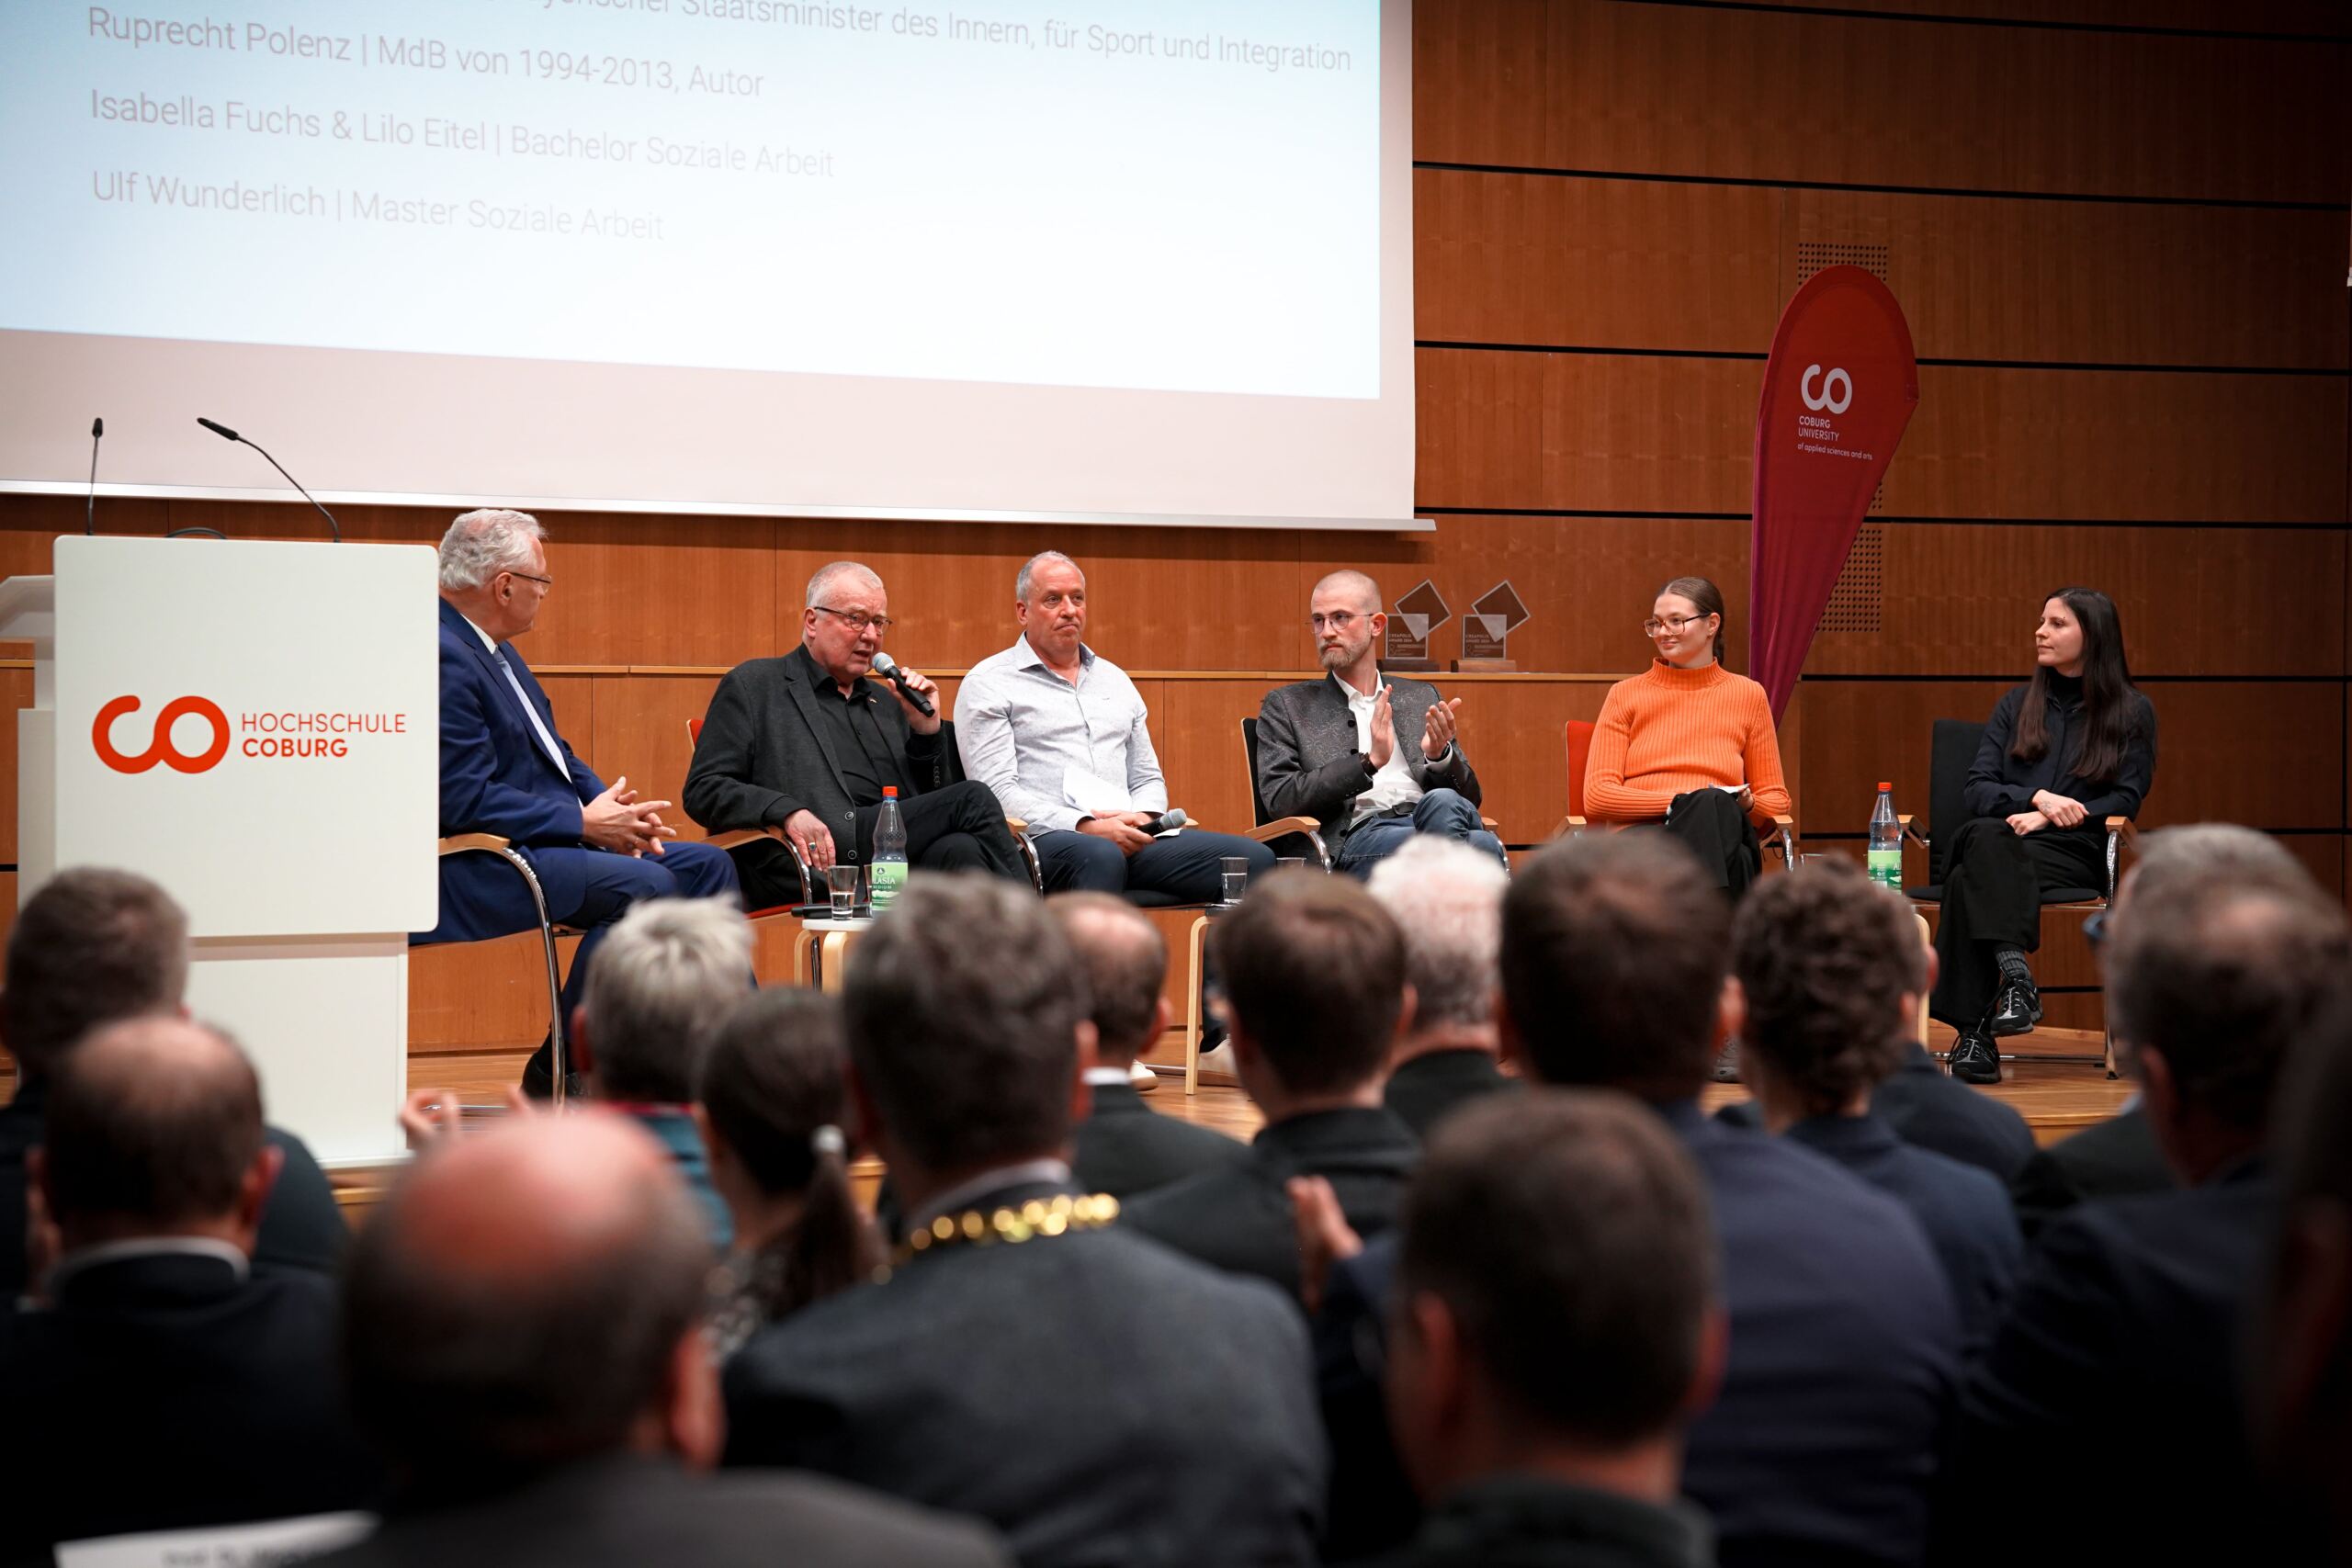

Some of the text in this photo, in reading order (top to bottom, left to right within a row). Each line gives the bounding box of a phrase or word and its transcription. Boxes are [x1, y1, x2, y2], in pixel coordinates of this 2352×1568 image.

[681, 0, 1351, 73] Staatsminister des Innern, für Sport und Integration
[89, 6, 236, 50] Ruprecht
[246, 22, 352, 62] Polenz
[379, 35, 447, 69] MdB
[456, 49, 508, 75] von
[519, 48, 679, 94] 1994-2013,
[689, 65, 764, 97] Autor
[91, 88, 215, 129] Isabella
[226, 101, 322, 138] Fuchs
[332, 110, 353, 141] &
[363, 113, 414, 144] Lilo
[424, 118, 485, 151] Eitel
[512, 125, 639, 164] Bachelor
[646, 136, 747, 172] Soziale
[754, 145, 834, 178] Arbeit
[93, 171, 140, 203] Ulf
[147, 175, 326, 218] Wunderlich
[353, 190, 459, 226] Master
[468, 199, 572, 234] Soziale
[581, 208, 664, 241] Arbeit
[1799, 415, 1830, 428] COBURG
[1798, 428, 1839, 441] UNIVERSITY
[1797, 442, 1873, 461] of applied sciences and arts
[242, 712, 406, 733] HOCHSCHULE
[242, 738, 348, 758] COBURG
